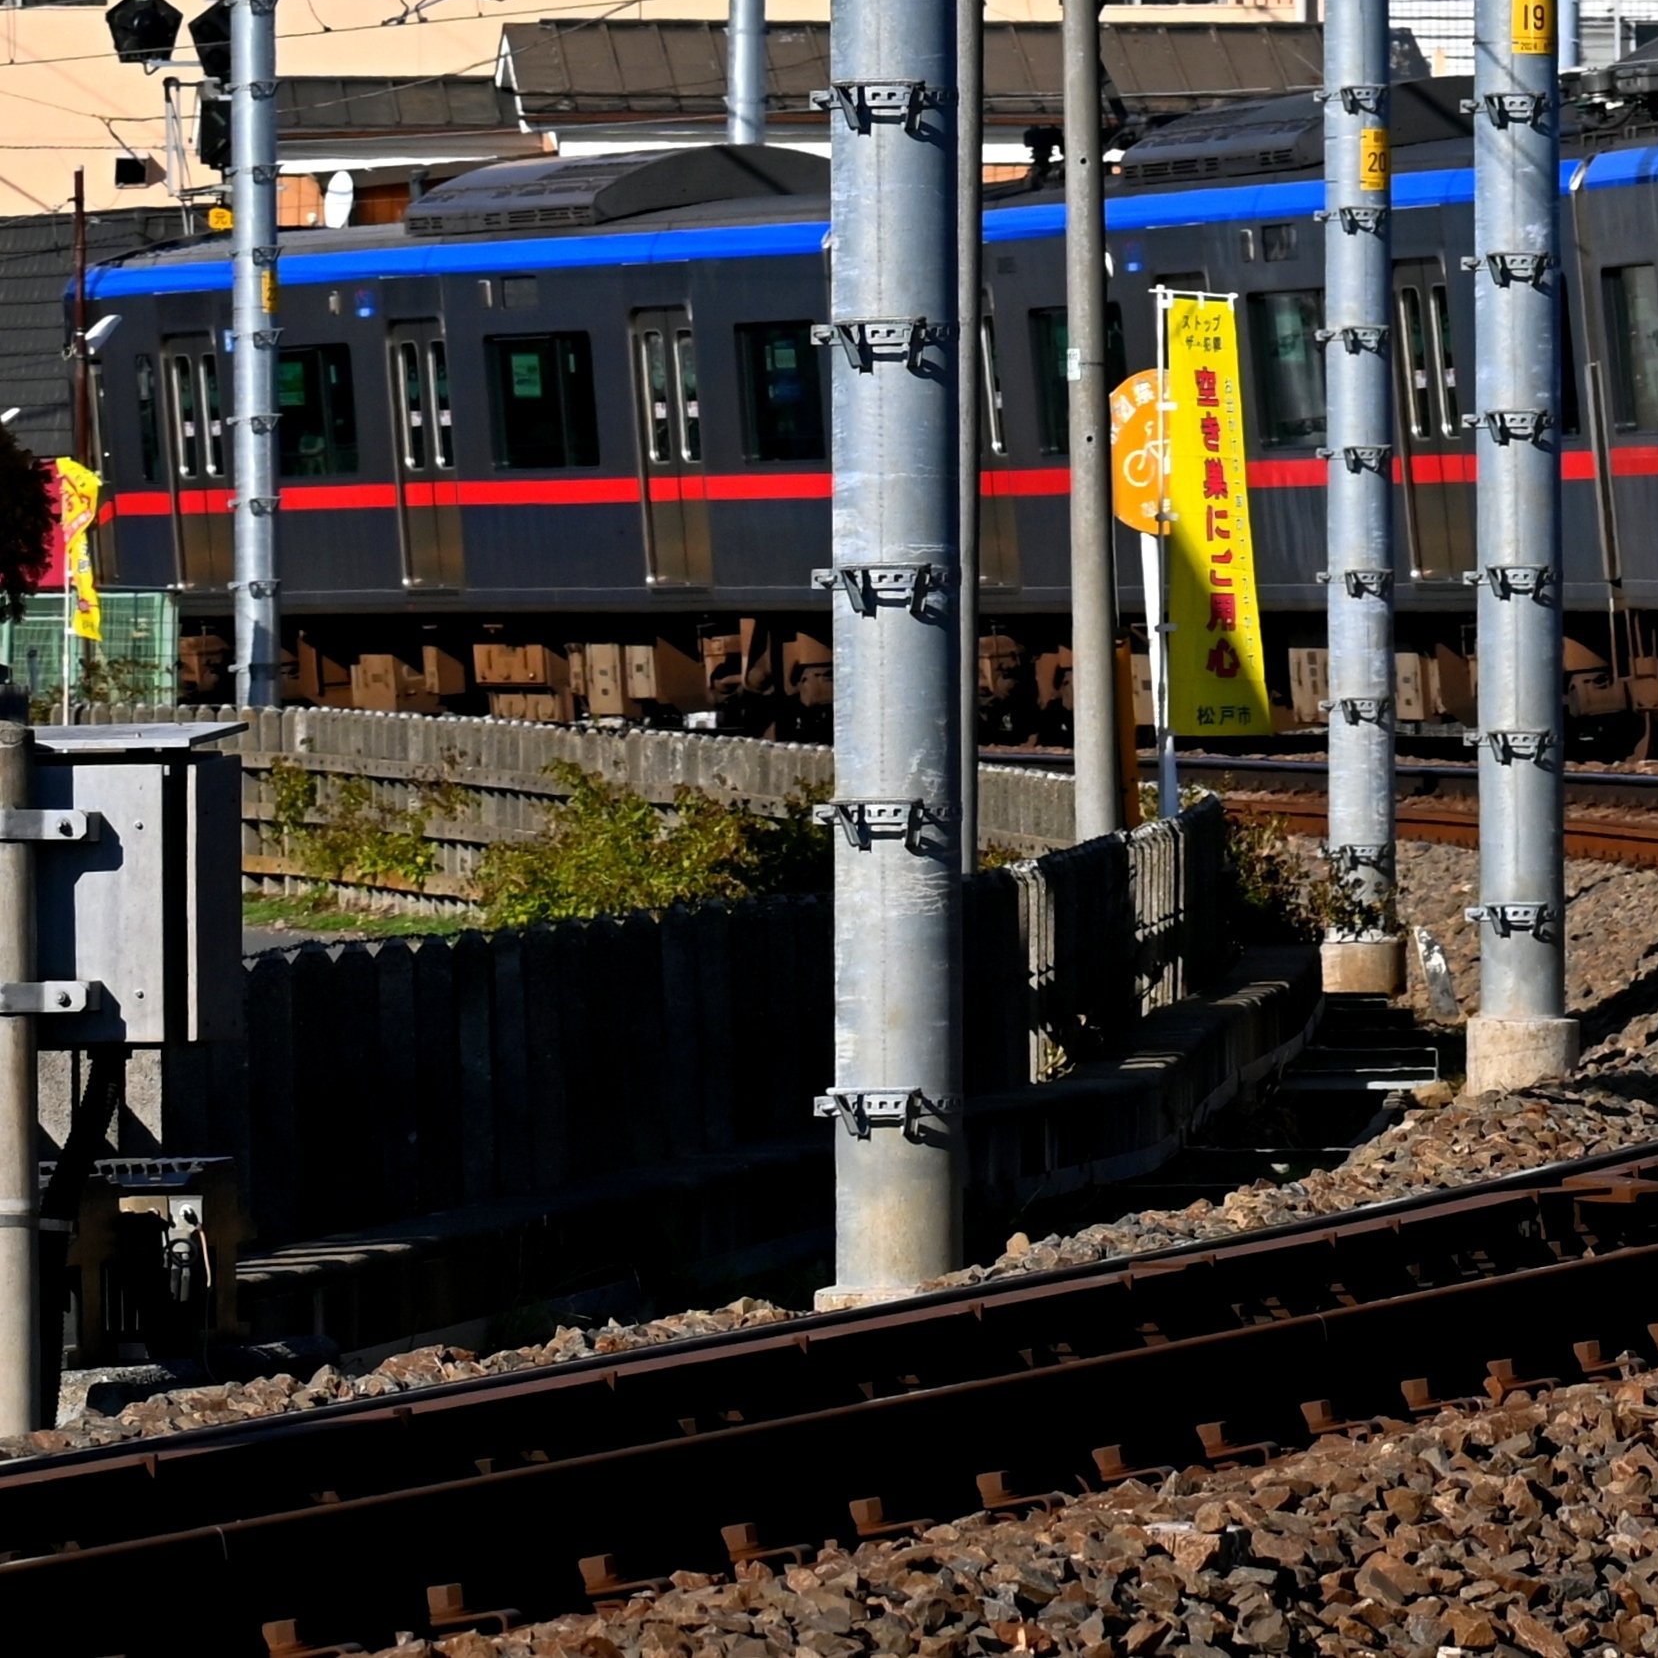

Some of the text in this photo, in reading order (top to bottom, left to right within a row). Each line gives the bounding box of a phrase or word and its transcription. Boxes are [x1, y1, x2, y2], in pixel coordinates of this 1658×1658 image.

[1523, 3, 1545, 31] 19
[1367, 151, 1387, 173] 20
[1182, 314, 1221, 332] ストップ
[1194, 365, 1241, 679] 空き巣にご用心
[1197, 704, 1252, 727] 松戸市
